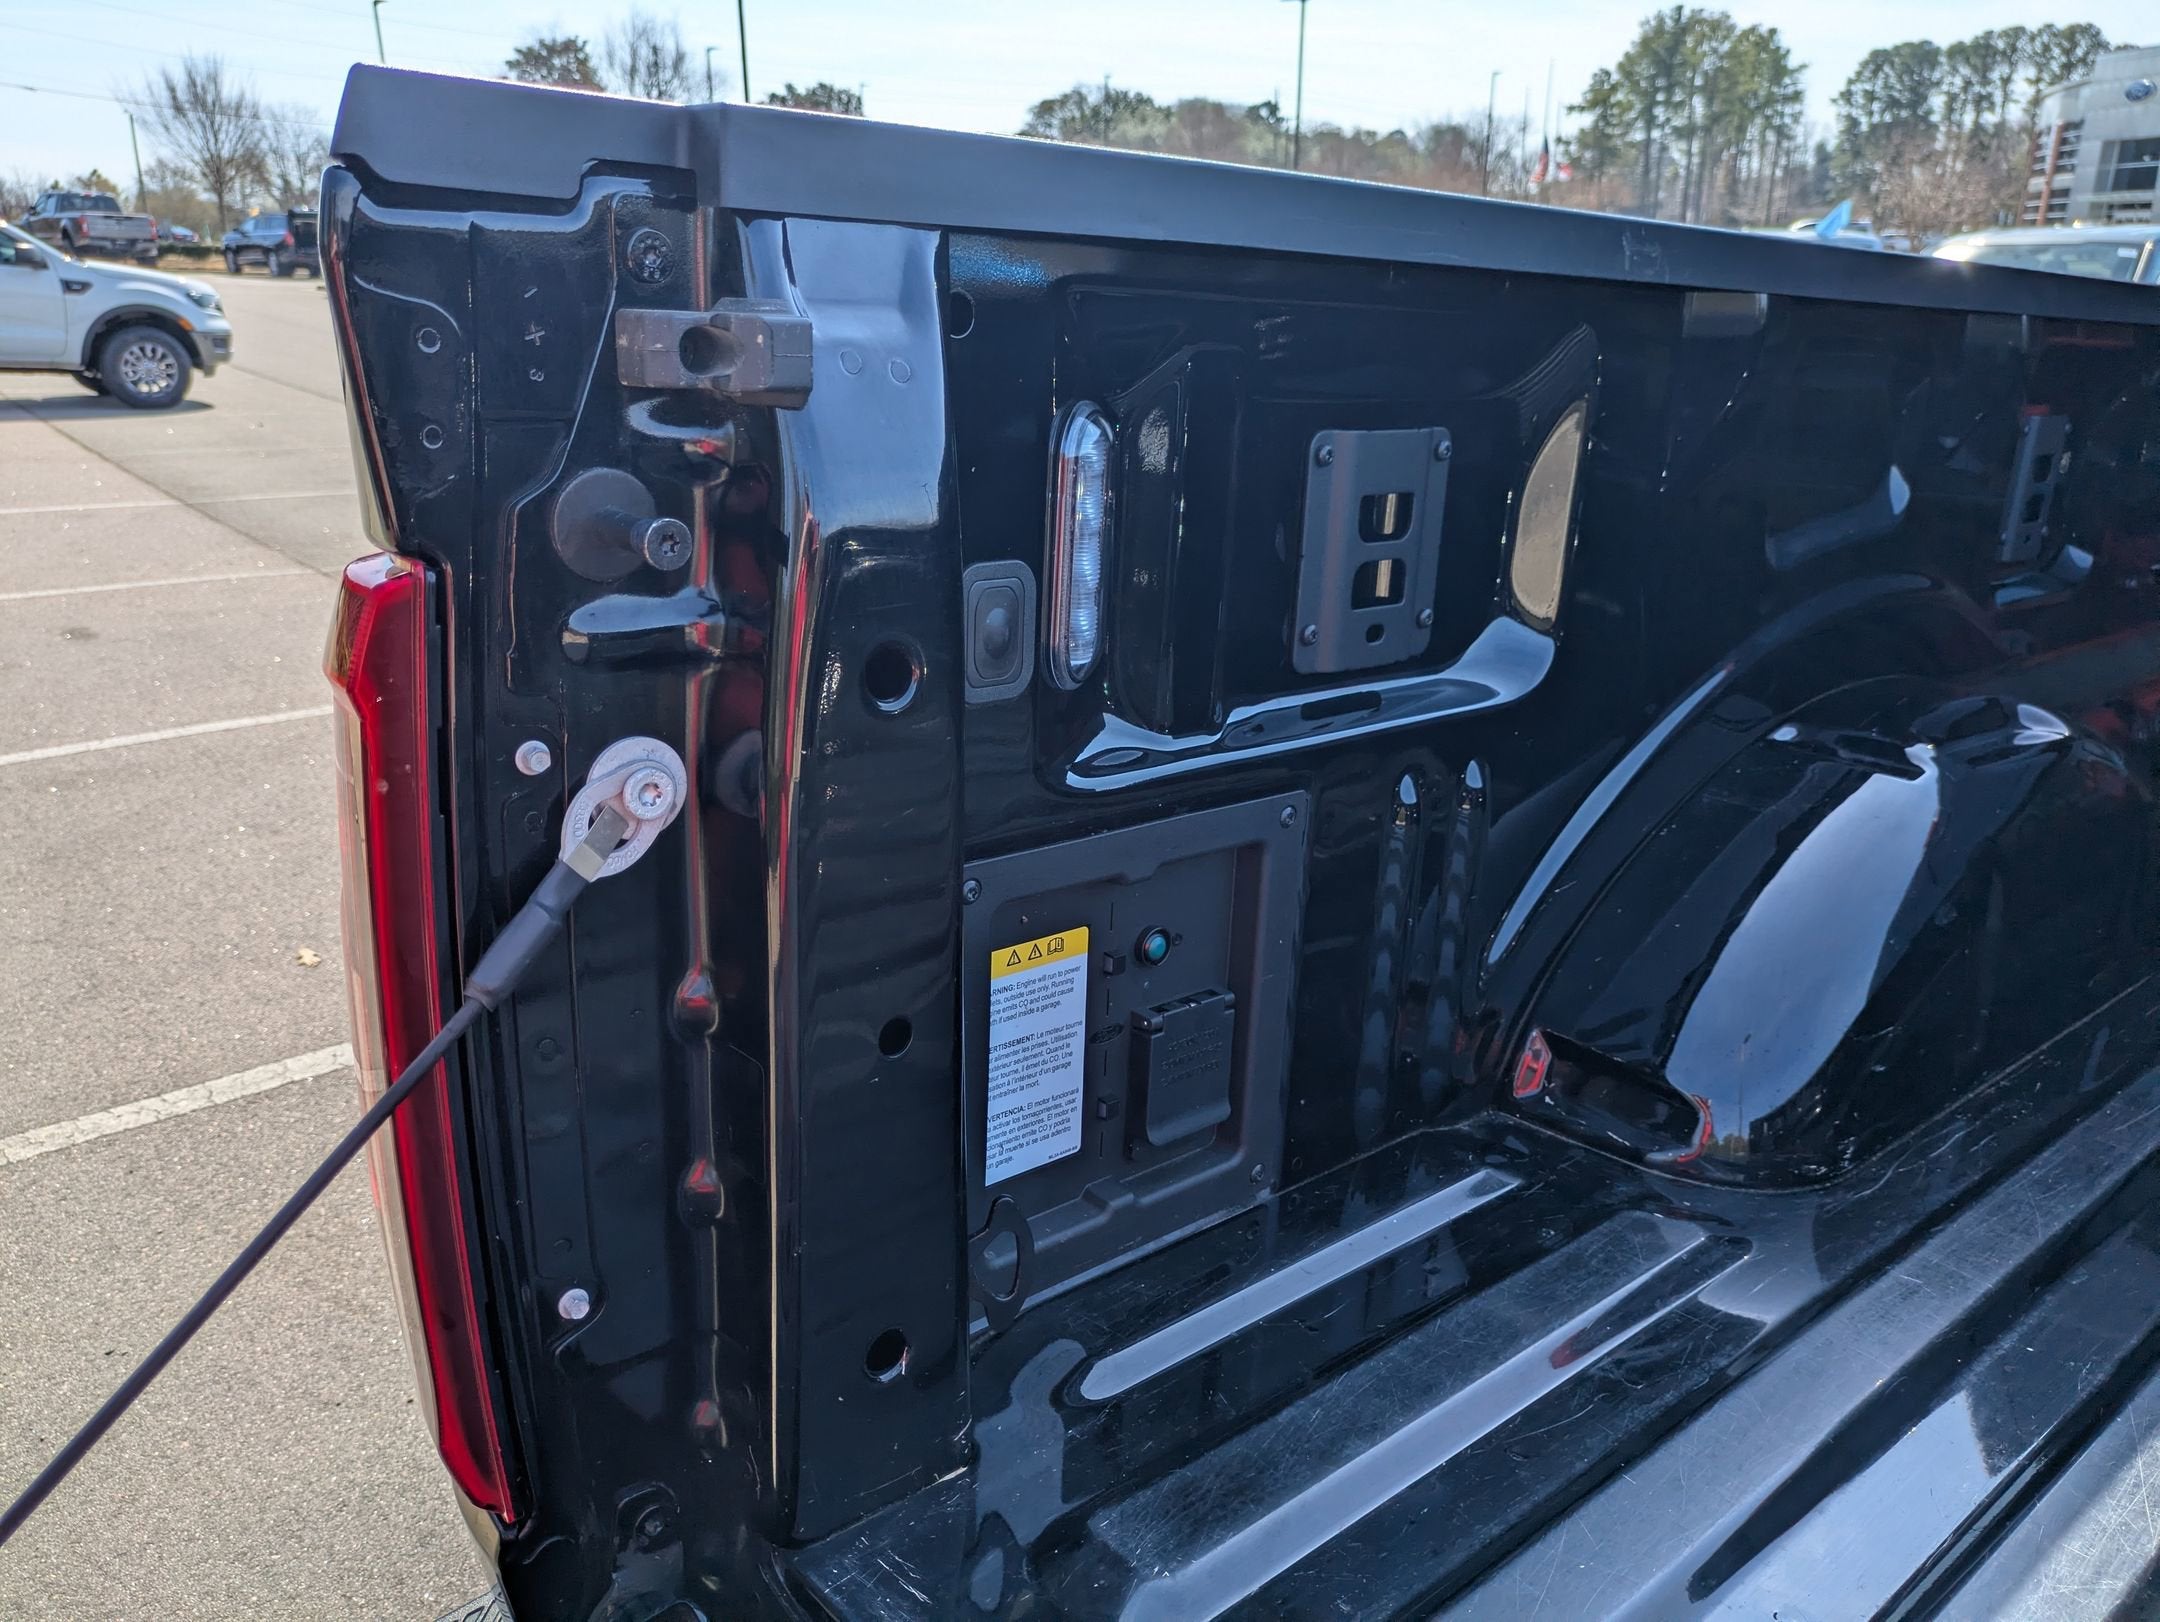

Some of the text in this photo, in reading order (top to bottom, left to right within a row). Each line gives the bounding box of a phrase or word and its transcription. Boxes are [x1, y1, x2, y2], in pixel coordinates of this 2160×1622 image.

[1017, 979, 1036, 989] Engine
[1037, 974, 1046, 983] will
[1064, 966, 1081, 977] power
[1004, 991, 1024, 1003] outside
[1026, 988, 1036, 996] use
[1037, 985, 1049, 993] only.
[1051, 977, 1074, 989] Running
[1002, 1003, 1017, 1013] emits
[1019, 999, 1028, 1008] CO
[1029, 996, 1040, 1005] and
[1041, 991, 1056, 1001] could
[1057, 987, 1074, 996] cause
[1003, 1012, 1017, 1022] used
[1018, 1008, 1035, 1018] inside
[1041, 1001, 1061, 1012] garage.
[1045, 1026, 1065, 1037] moteur
[1066, 1020, 1083, 1030] tourne
[994, 1050, 1020, 1062] alimenter
[1031, 1041, 1049, 1051] prises.
[1051, 1032, 1078, 1044] Utilisation
[1046, 1044, 1065, 1055] Quand
[1049, 1055, 1059, 1064] CO.
[1062, 1051, 1073, 1060] Une
[1051, 1061, 1071, 1073] garage
[1026, 1080, 1040, 1090] mort.
[1027, 1102, 1033, 1110] El
[1034, 1098, 1050, 1108] motor
[1047, 1114, 1053, 1122] El
[1054, 1110, 1069, 1119] motor
[993, 1121, 1011, 1131] activar
[1022, 1130, 1037, 1139] emite
[1038, 1125, 1048, 1134] CO
[1005, 1143, 1024, 1154] muerte
